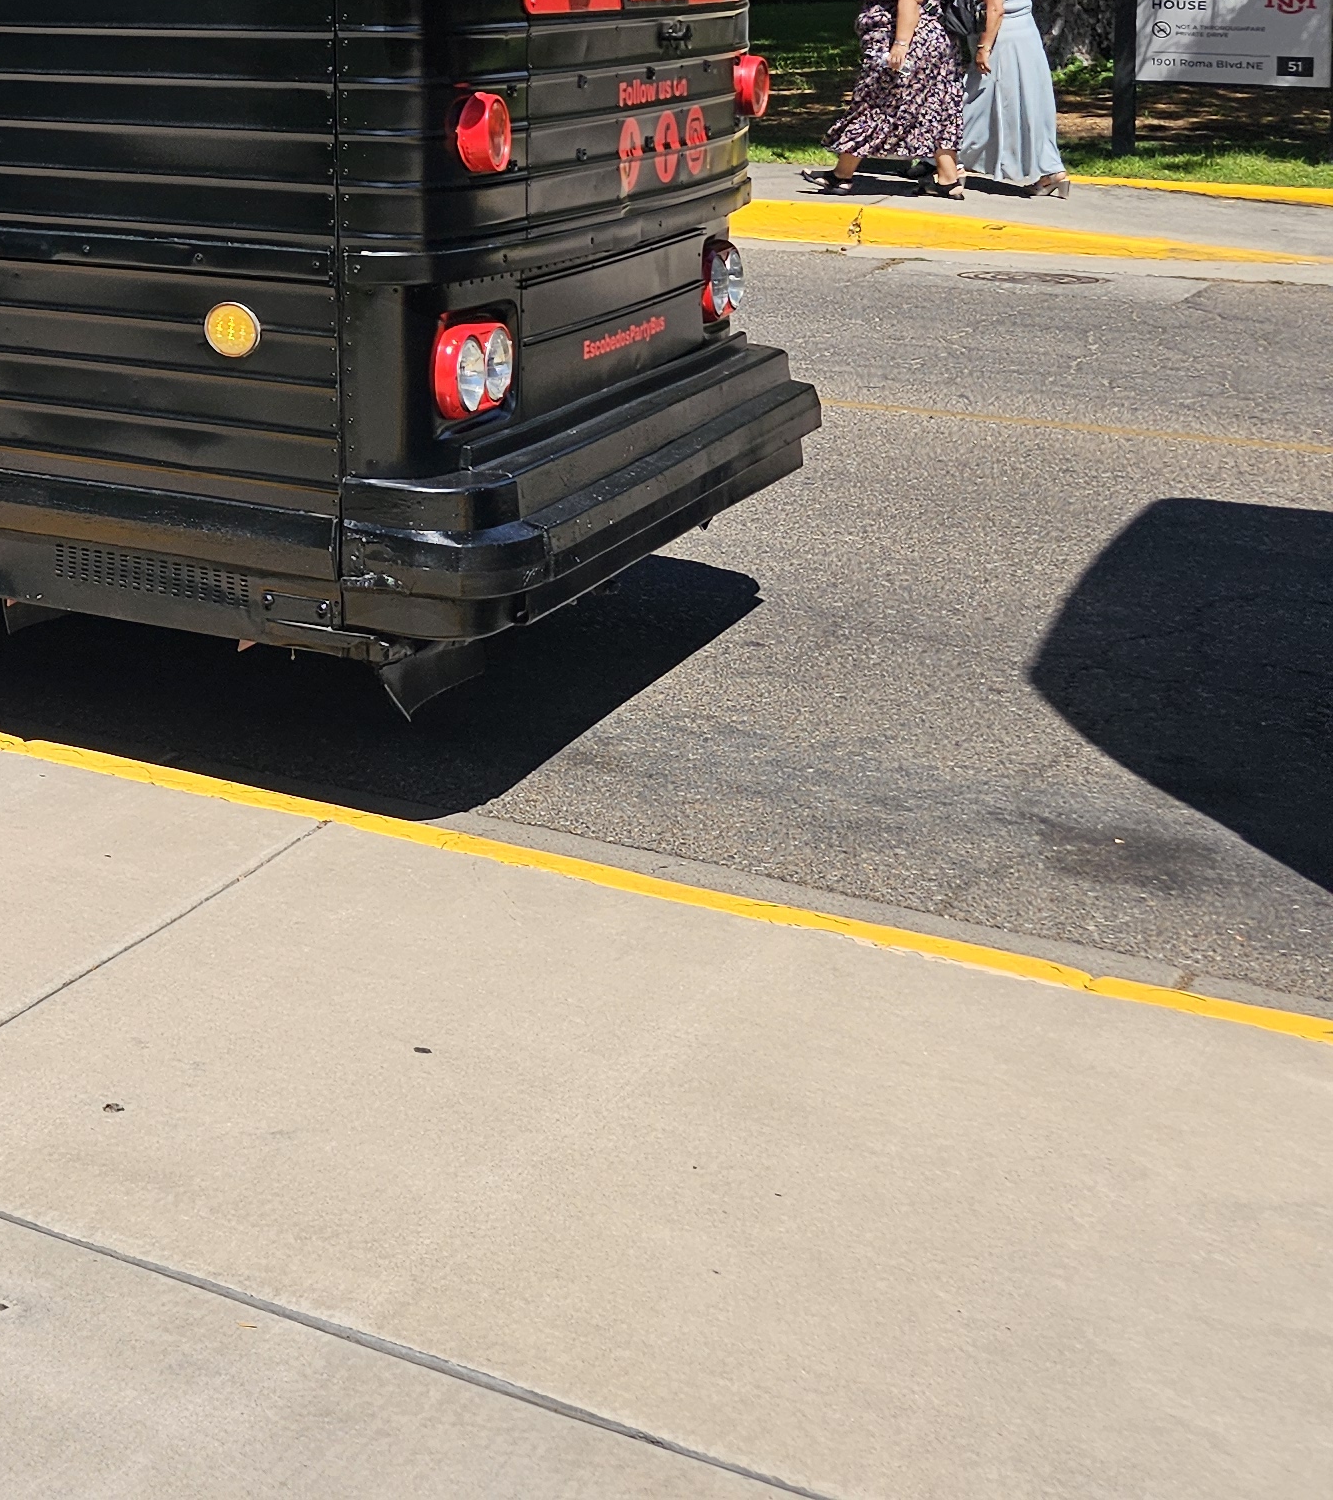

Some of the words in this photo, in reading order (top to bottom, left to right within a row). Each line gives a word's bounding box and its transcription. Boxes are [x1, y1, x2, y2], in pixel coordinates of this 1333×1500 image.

[1152, 0, 1207, 11] HOUSE
[1152, 58, 1175, 66] 1901
[1180, 59, 1213, 68] Roma
[1287, 61, 1303, 72] 51
[619, 79, 656, 107] Follow
[658, 80, 672, 100] us
